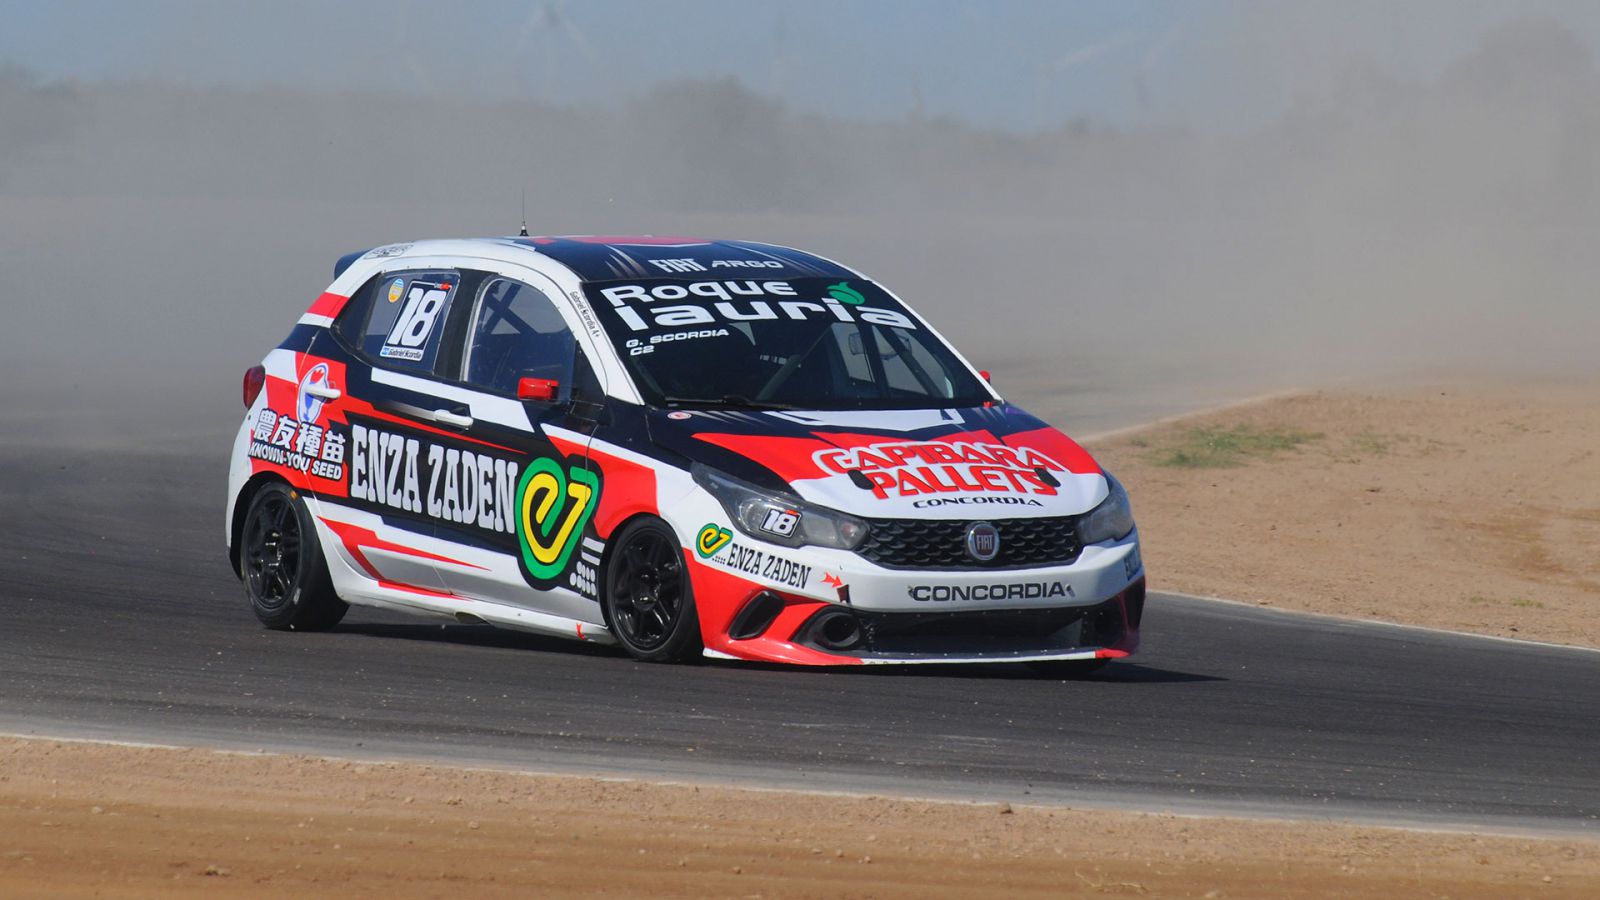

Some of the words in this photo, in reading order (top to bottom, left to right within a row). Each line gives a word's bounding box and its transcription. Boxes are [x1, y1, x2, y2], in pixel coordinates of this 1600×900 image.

[648, 258, 707, 272] FIAT
[711, 260, 784, 269] ARGO
[600, 281, 798, 307] Roque
[387, 287, 447, 347] 18
[626, 338, 644, 348] G.
[650, 328, 729, 344] SCORDIA
[629, 345, 655, 356] C2
[254, 408, 346, 463] 農友種苗
[249, 441, 311, 472] KNOWN-YOU
[311, 460, 342, 480] SEED
[819, 444, 1064, 473] CAPIBARA
[350, 424, 422, 514] ENZA
[427, 444, 518, 534] ZADEN
[862, 466, 1059, 499] PALLETS
[913, 496, 1043, 509] CONCORDIA
[764, 509, 798, 535] 18
[976, 534, 994, 551] FIAT
[727, 543, 763, 575] ENZA
[762, 554, 811, 589] ZADEN
[912, 582, 1065, 602] CONCORDIA
